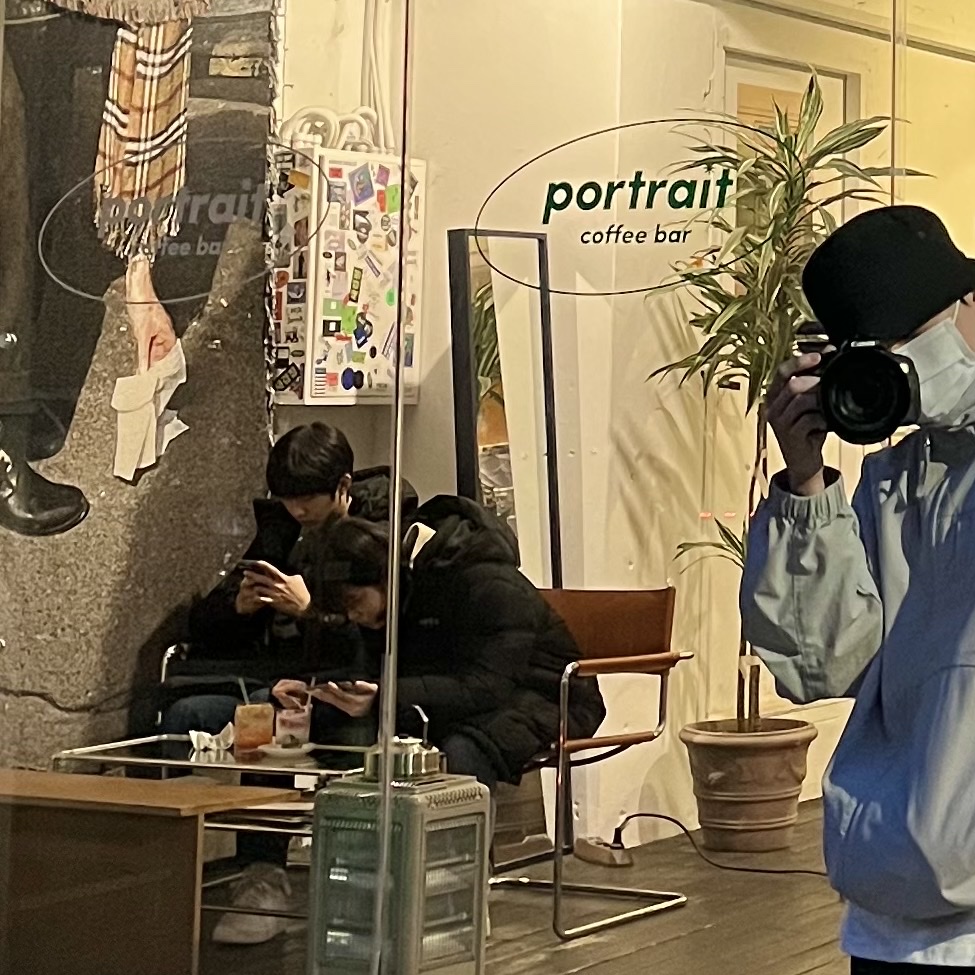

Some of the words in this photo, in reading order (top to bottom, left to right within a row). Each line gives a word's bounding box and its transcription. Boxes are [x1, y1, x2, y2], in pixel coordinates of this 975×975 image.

[542, 166, 734, 224] portrait
[580, 225, 647, 244] coffee
[655, 224, 692, 243] bar
